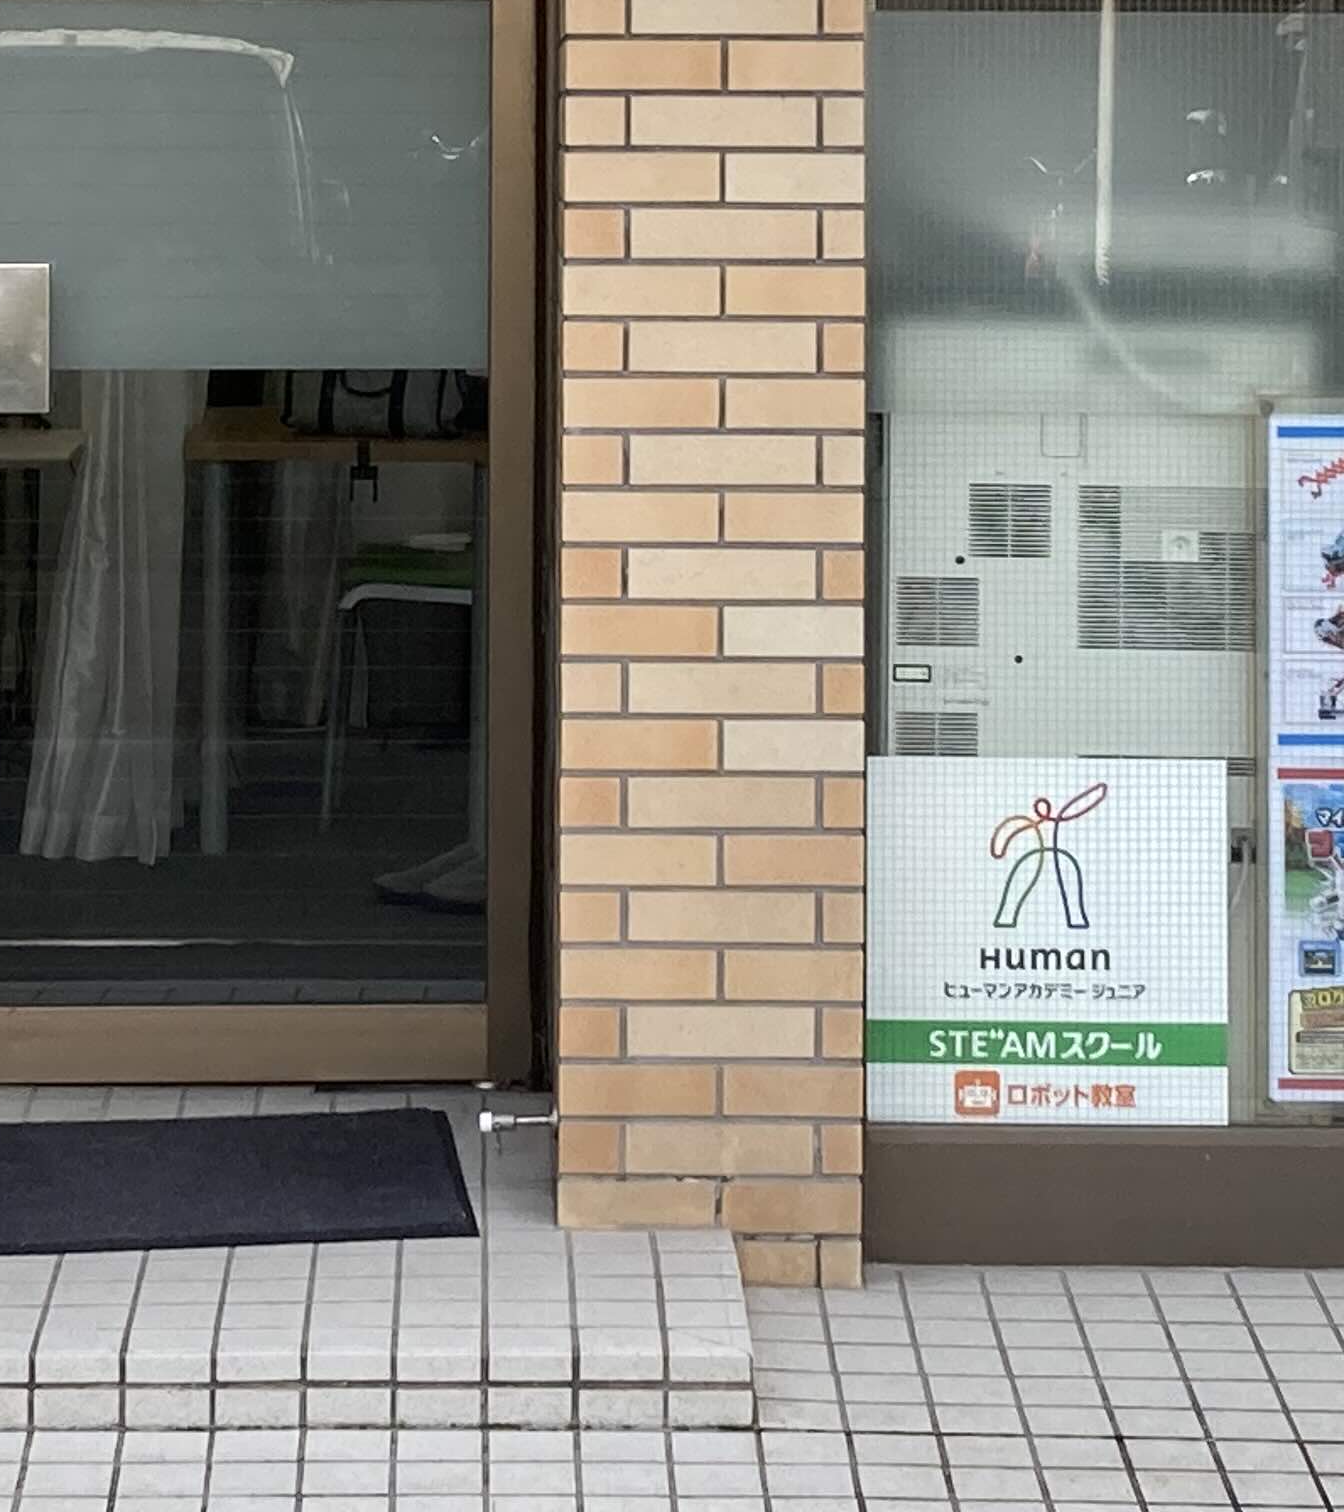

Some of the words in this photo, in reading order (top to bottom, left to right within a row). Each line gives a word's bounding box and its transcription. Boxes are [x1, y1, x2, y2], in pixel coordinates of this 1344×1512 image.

[980, 947, 1112, 971] Human
[1007, 1083, 1137, 1109] ロボット教室
